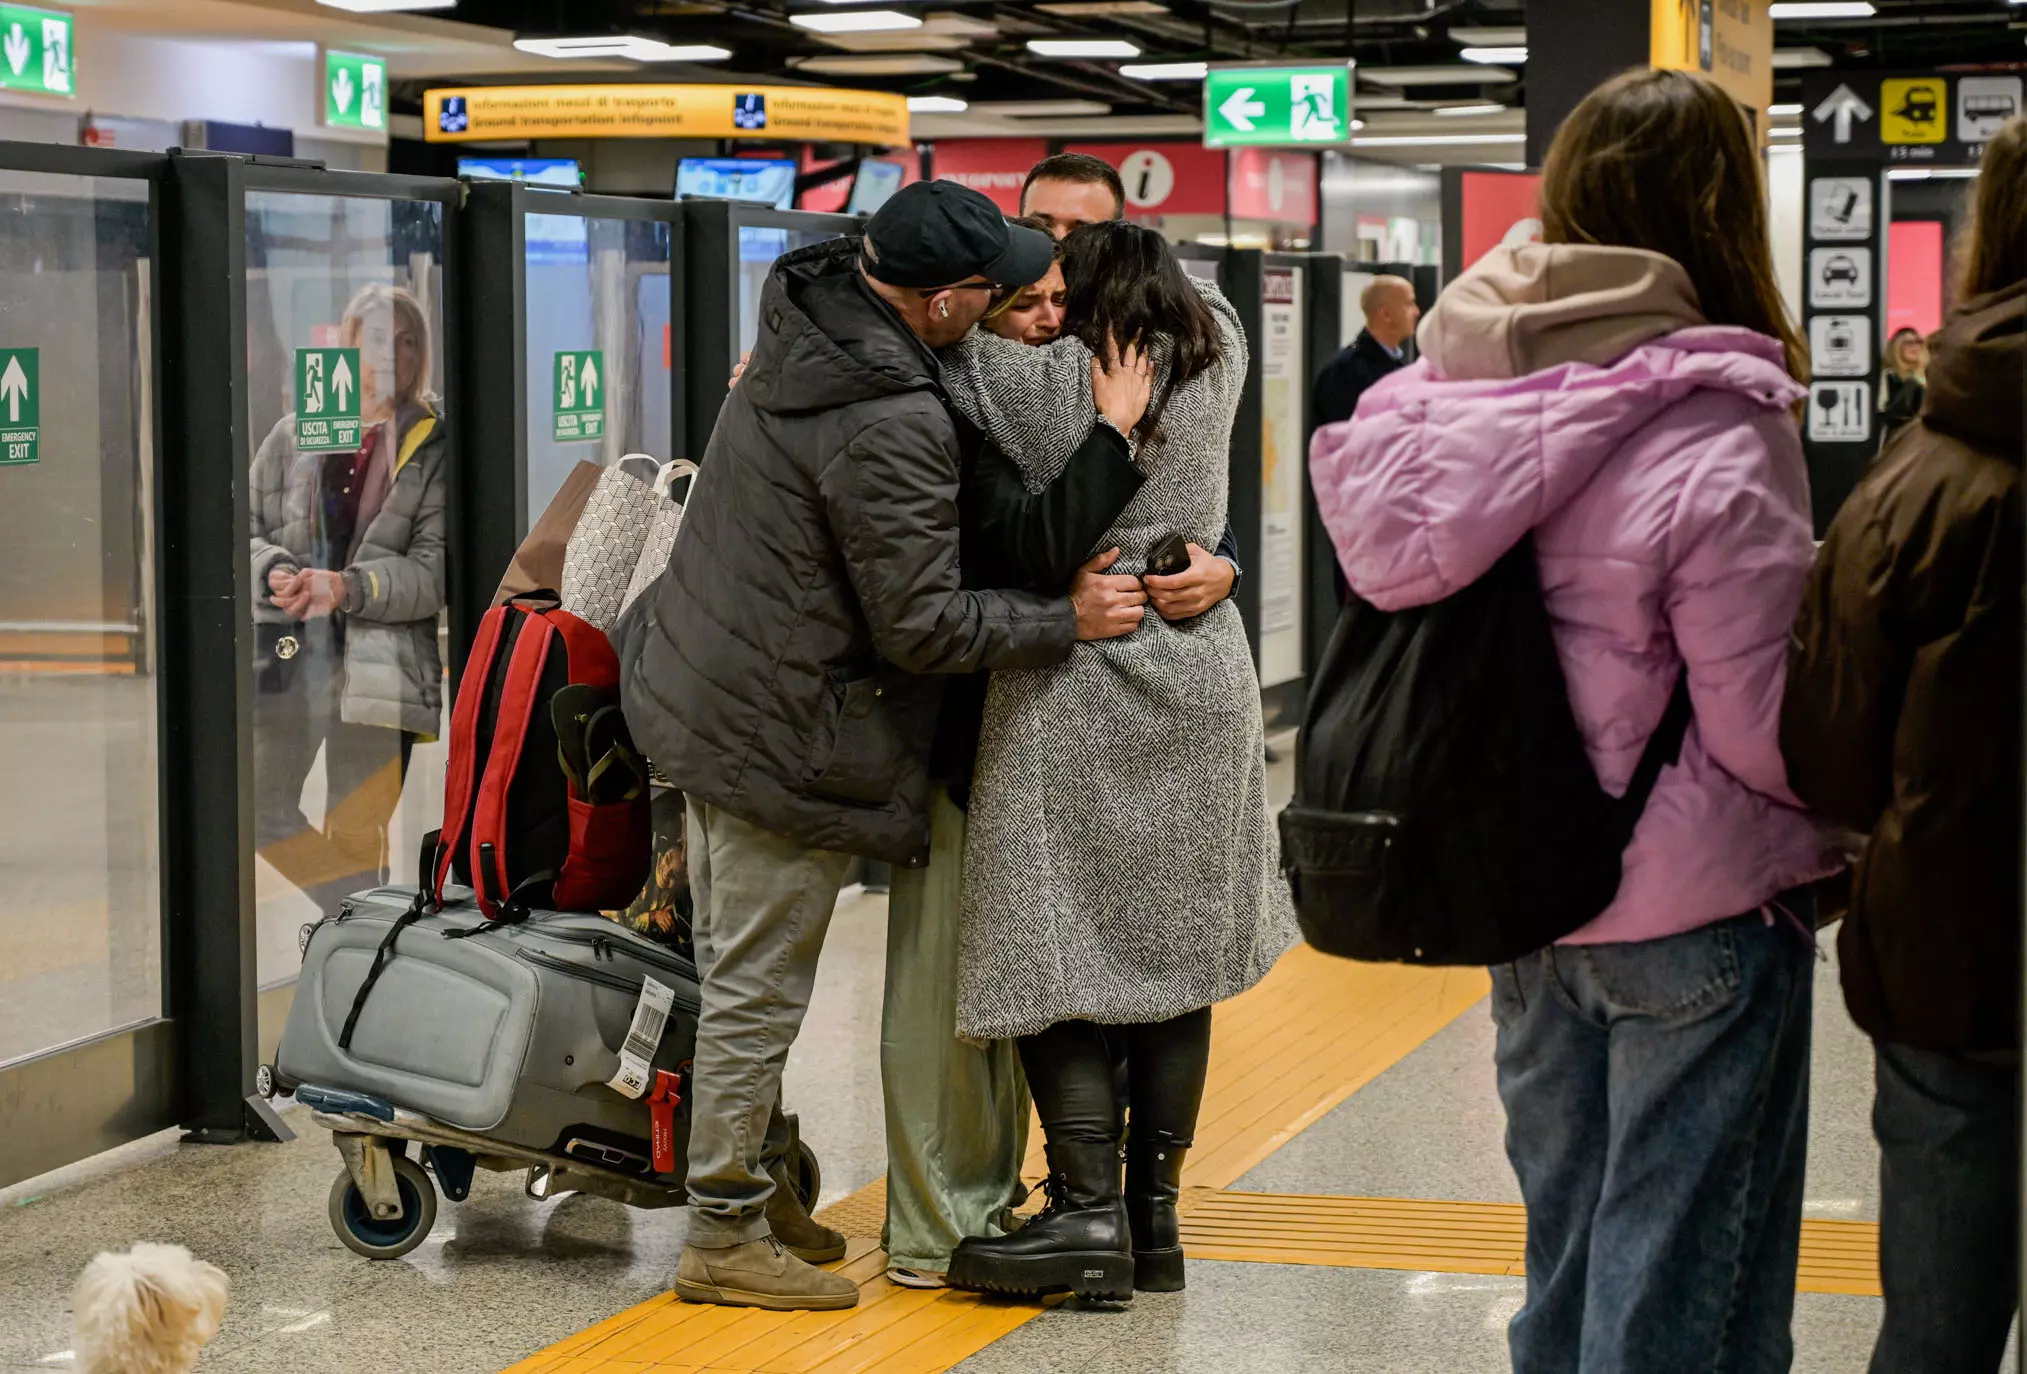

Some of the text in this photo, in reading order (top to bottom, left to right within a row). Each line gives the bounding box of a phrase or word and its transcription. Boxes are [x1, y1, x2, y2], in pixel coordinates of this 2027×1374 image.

[302, 421, 328, 436] USCITA
[1, 431, 37, 443] EMERGENCY
[338, 430, 354, 444] EXIT
[9, 443, 30, 459] EXIT
